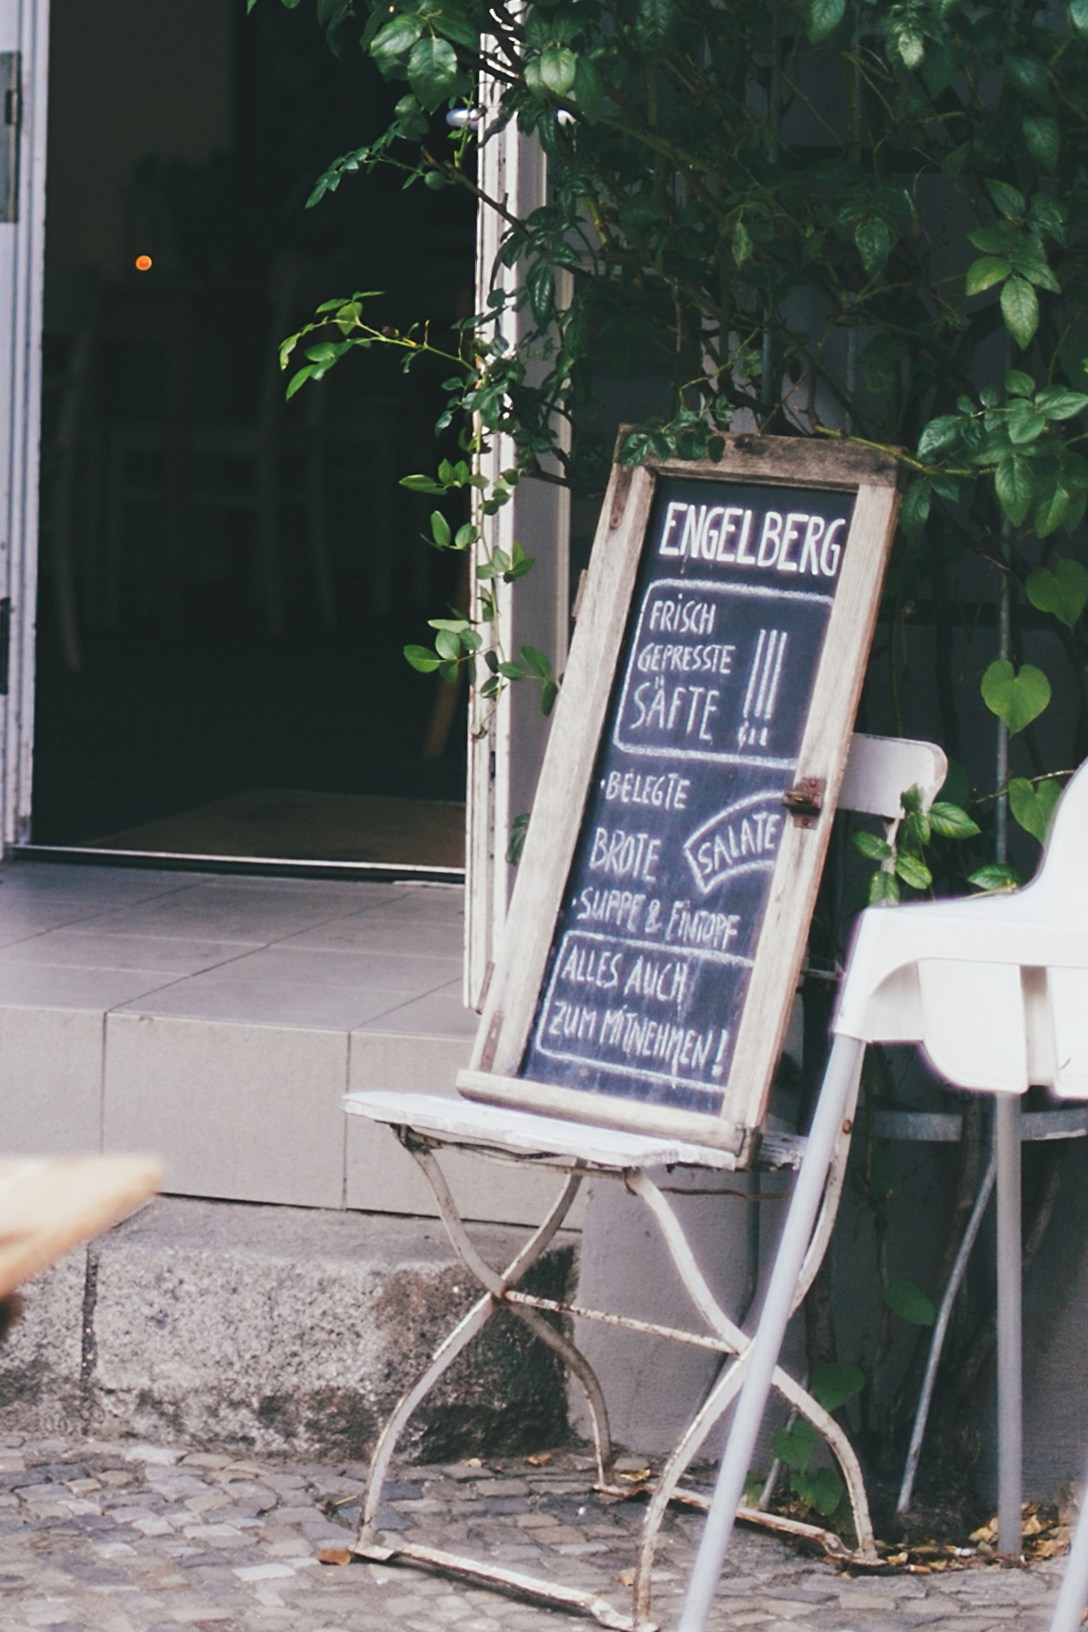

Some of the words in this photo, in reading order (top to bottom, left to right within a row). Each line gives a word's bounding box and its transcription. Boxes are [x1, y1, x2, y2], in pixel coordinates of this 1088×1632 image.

[659, 501, 846, 577] ENGELBERG
[649, 594, 716, 634] FRISCH
[637, 642, 735, 674] GEPRESSTE
[630, 675, 720, 741] SÄFTE
[589, 827, 662, 883] BROTE
[697, 812, 781, 875] SALATE
[645, 900, 662, 933] &
[665, 900, 741, 949] EINTOPF
[561, 946, 623, 988] ALLES
[624, 955, 689, 1003] AUCH
[549, 1001, 599, 1039] ZUM
